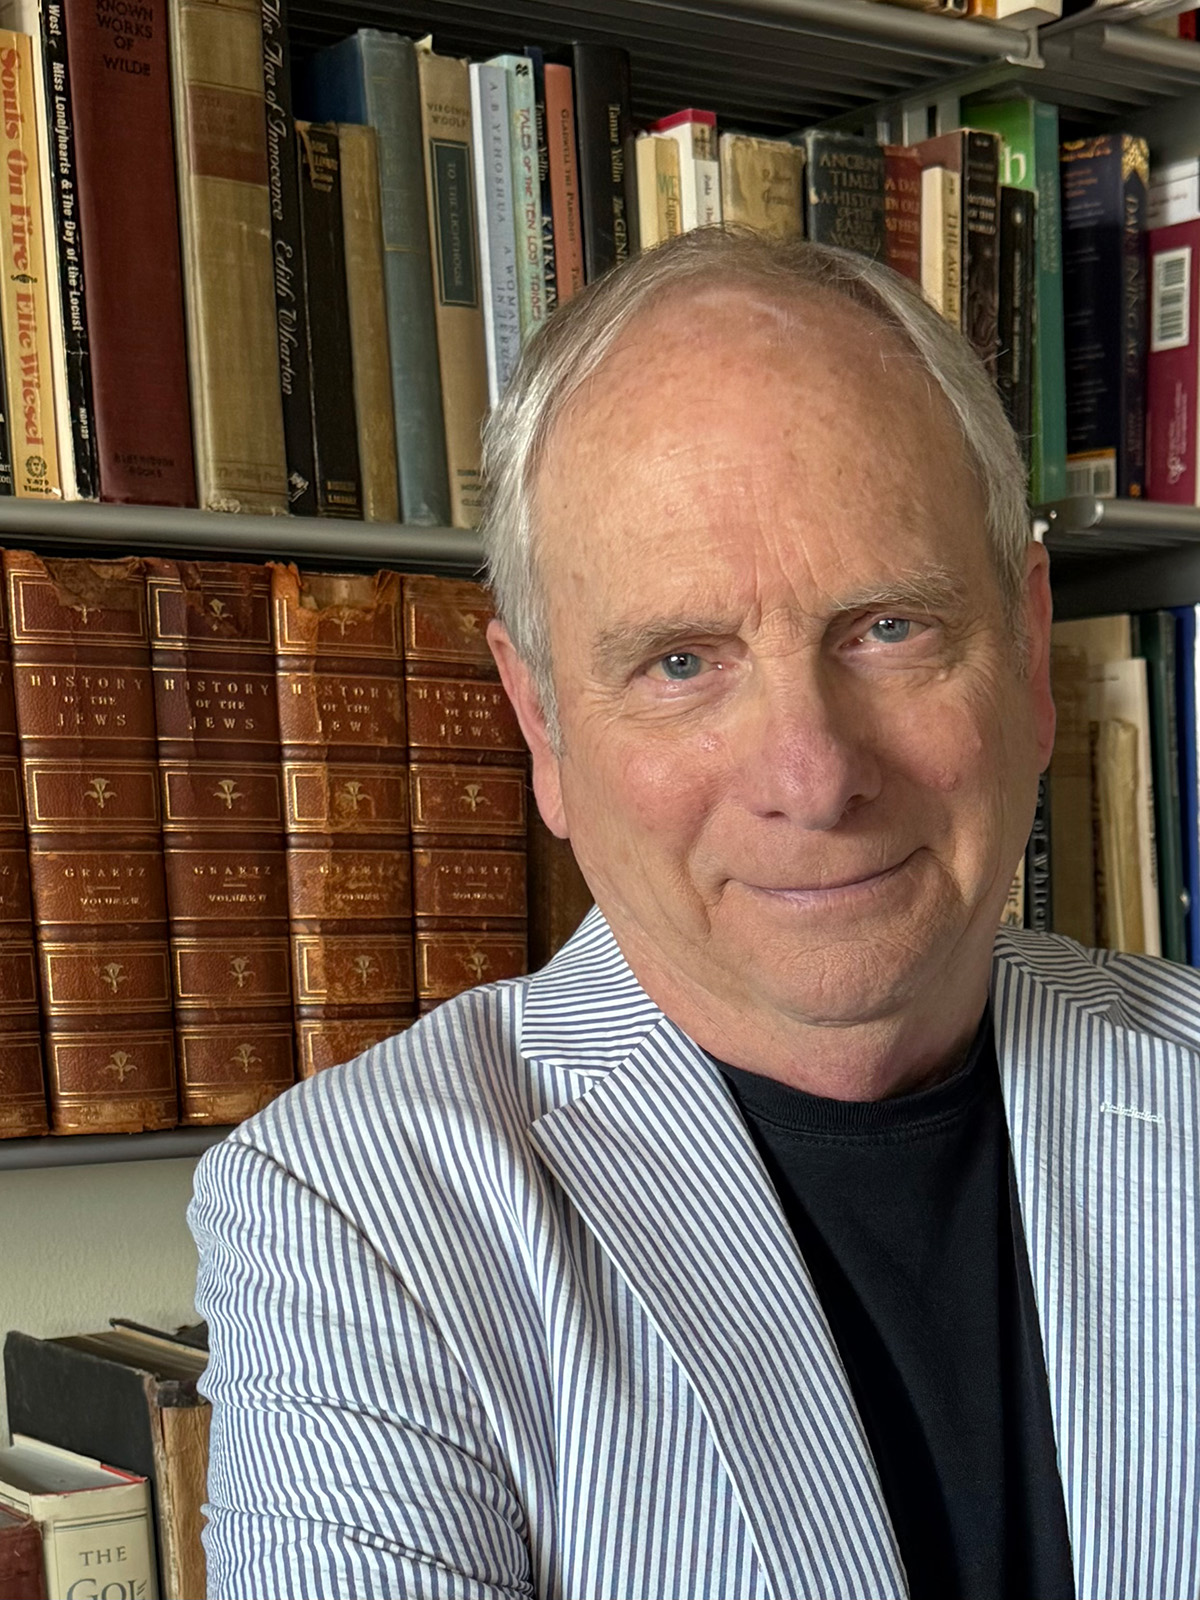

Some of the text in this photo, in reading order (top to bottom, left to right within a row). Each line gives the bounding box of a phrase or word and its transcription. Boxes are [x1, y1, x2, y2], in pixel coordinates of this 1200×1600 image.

[96, 0, 153, 21] KNOWN
[96, 13, 152, 38] WORKS
[114, 36, 134, 49] OF
[102, 54, 150, 76] WILDE
[561, 108, 572, 164] GLADWELL
[48, 4, 84, 332] West Miss Lonelyhearts & The Day of the Locust
[491, 124, 506, 223] YEHOSHUA
[609, 104, 627, 265] Tamar Yellin The GENI
[830, 170, 879, 190] TIMES
[260, 0, 298, 396] The Age of Innocence Edith Wharton
[446, 162, 464, 287] TO THE LIGHTHOUSE
[519, 107, 543, 322] TALES OF THE TEN LOST TRIBES
[947, 212, 957, 243] THE
[0, 47, 44, 445] Souls On Fire Elie Wiesel
[541, 216, 555, 281] KAFKA
[503, 246, 518, 335] A WOMAN
[497, 286, 511, 386] IN JERUSA
[31, 675, 142, 690] HISTORY
[164, 679, 269, 695] HISTORY
[292, 683, 394, 698] HISTORY
[91, 696, 116, 705] THE
[195, 699, 246, 710] OF THE
[415, 688, 501, 704] HISTOR
[347, 704, 370, 713] THE
[468, 709, 492, 719] THE
[57, 712, 126, 727] JEWS
[188, 717, 255, 730] JEWS
[316, 719, 379, 732] JEWS
[439, 723, 500, 737] JEWS
[1033, 852, 1050, 932] Whiten
[79, 1546, 128, 1567] THE
